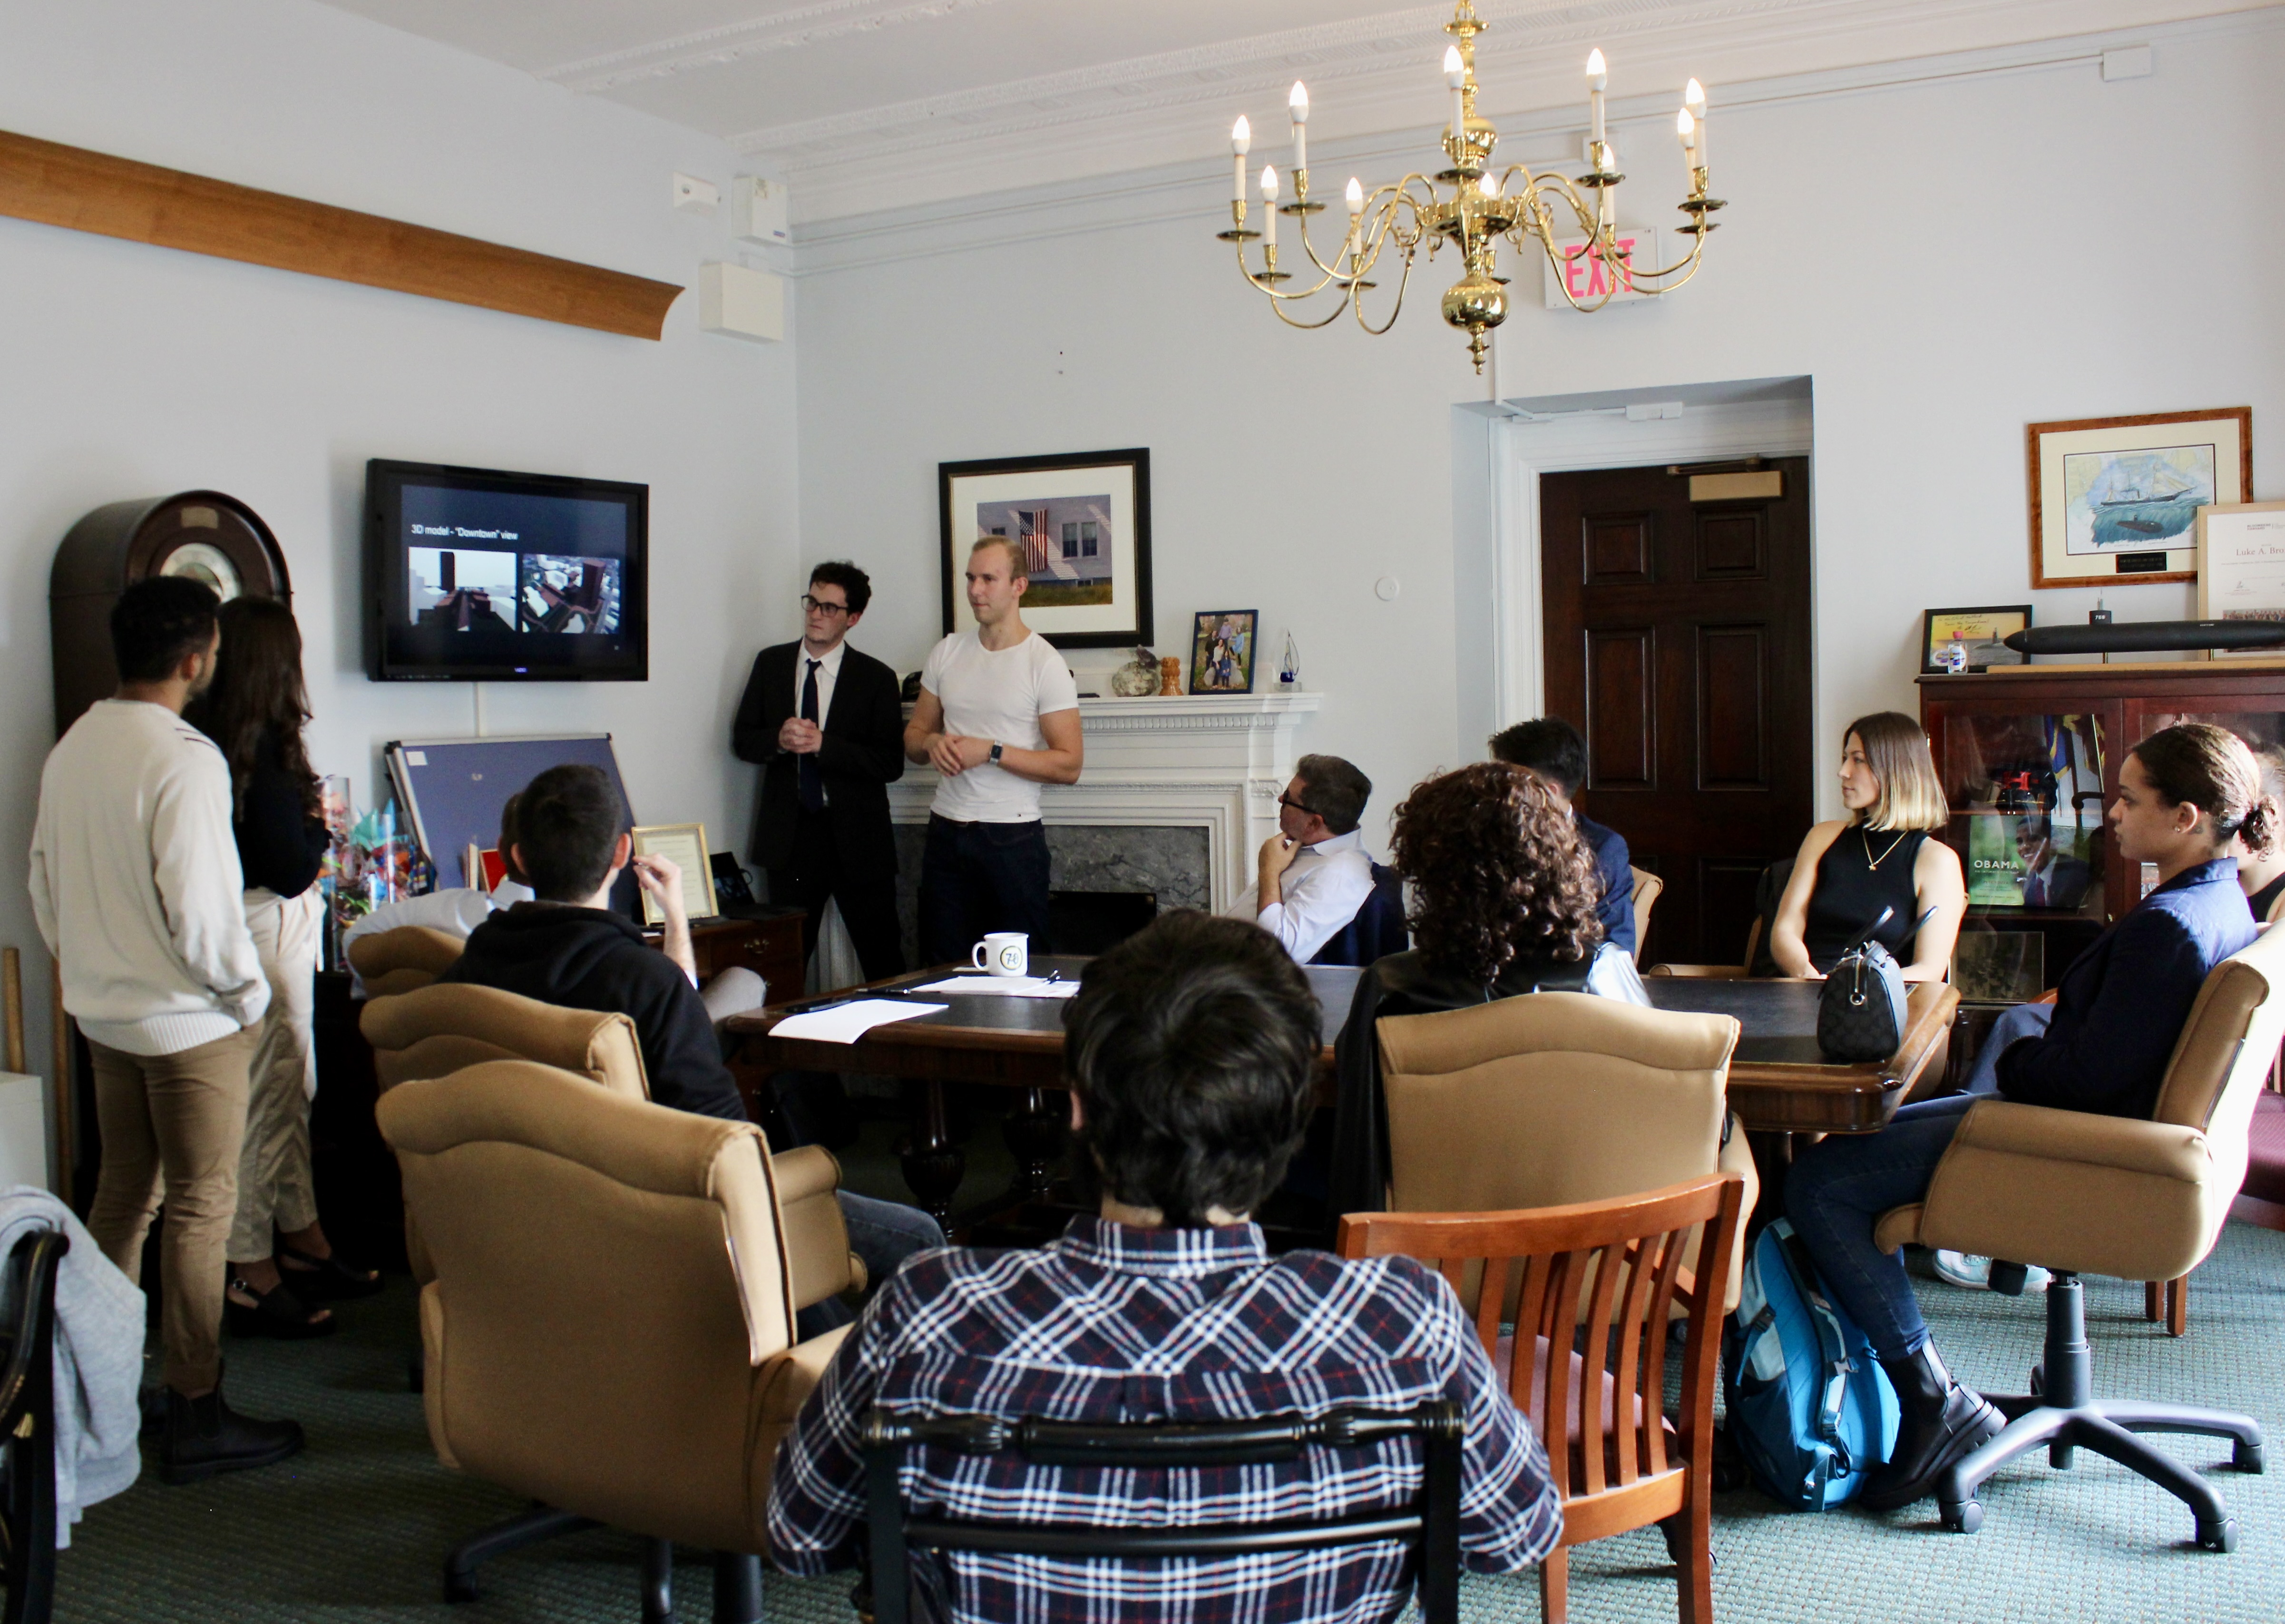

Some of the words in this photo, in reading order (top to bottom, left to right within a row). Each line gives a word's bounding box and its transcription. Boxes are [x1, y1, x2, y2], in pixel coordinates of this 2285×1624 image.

[1564, 238, 1635, 298] EXIT
[411, 524, 424, 534] 3D
[424, 526, 450, 536] model
[500, 530, 519, 540] view
[2236, 548, 2256, 556] Luke
[1974, 860, 2019, 870] OBAMA
